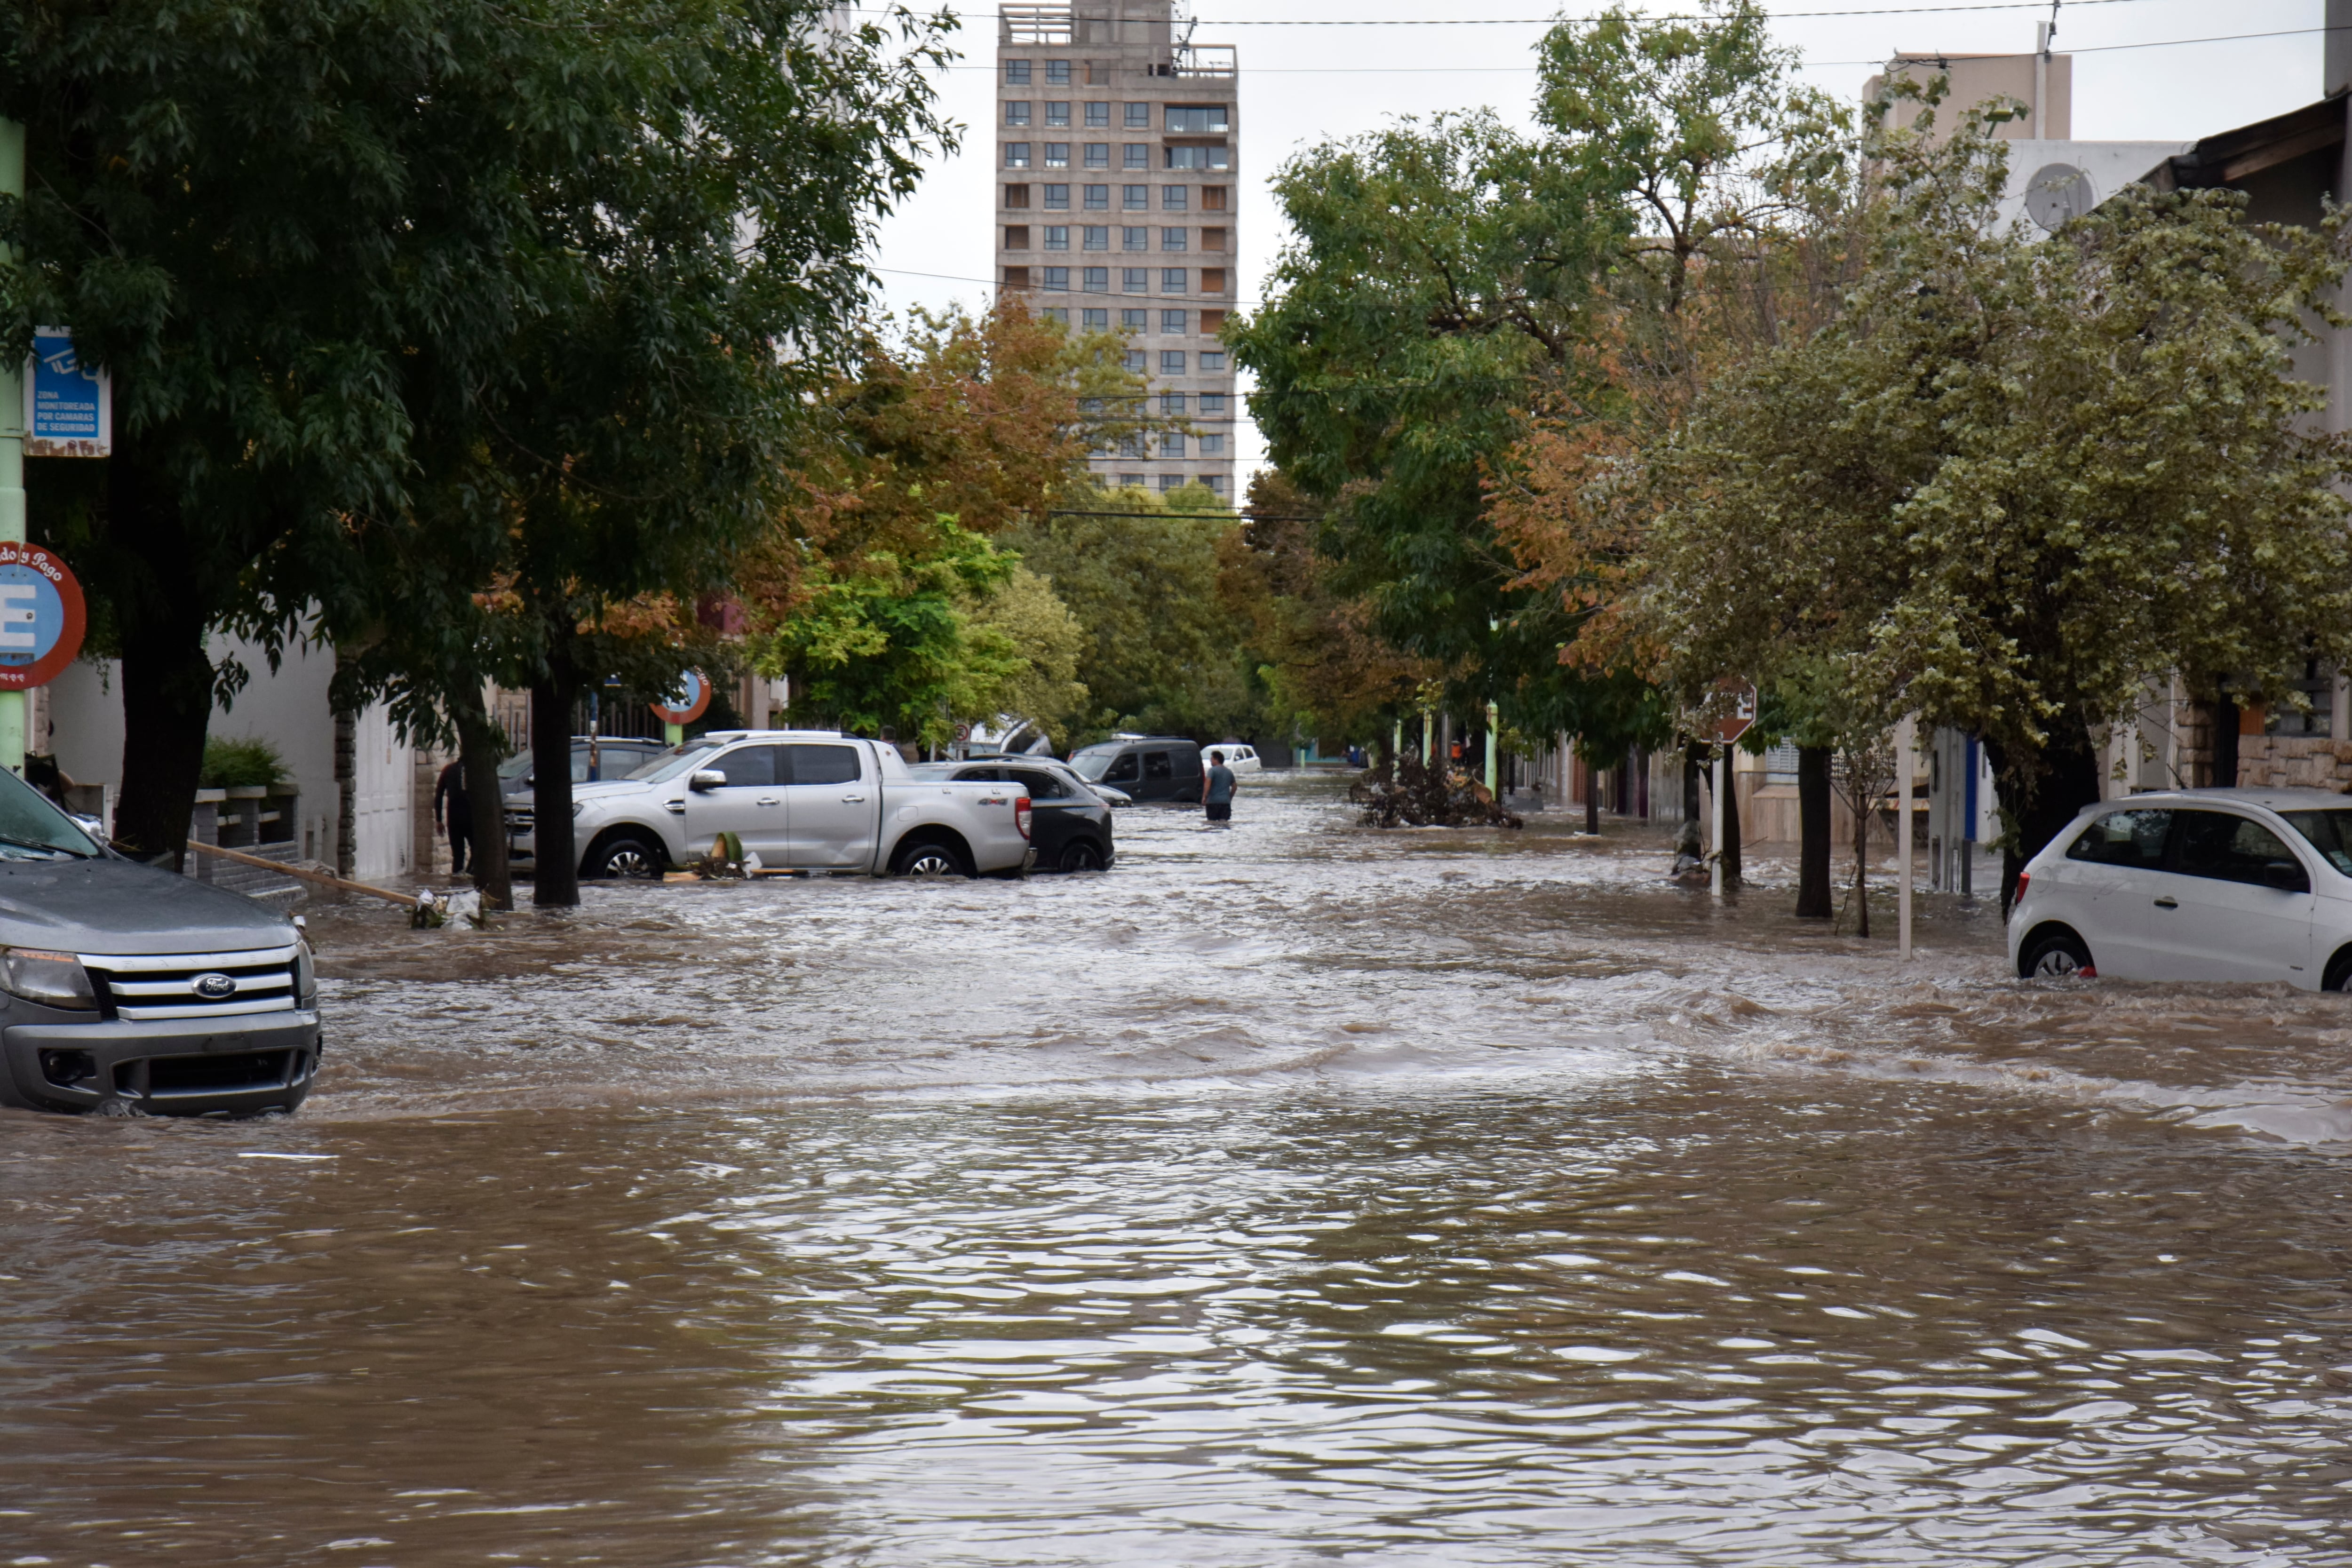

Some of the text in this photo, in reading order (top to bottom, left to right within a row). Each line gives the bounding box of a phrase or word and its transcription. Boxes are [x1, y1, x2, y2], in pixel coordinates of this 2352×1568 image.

[38, 402, 95, 410] MONITOREADA
[56, 413, 94, 421] CAMARAS
[50, 423, 95, 431] SEGURIDAD
[0, 547, 62, 581] do y Pago
[0, 584, 36, 647] E
[206, 978, 230, 991] Ford
